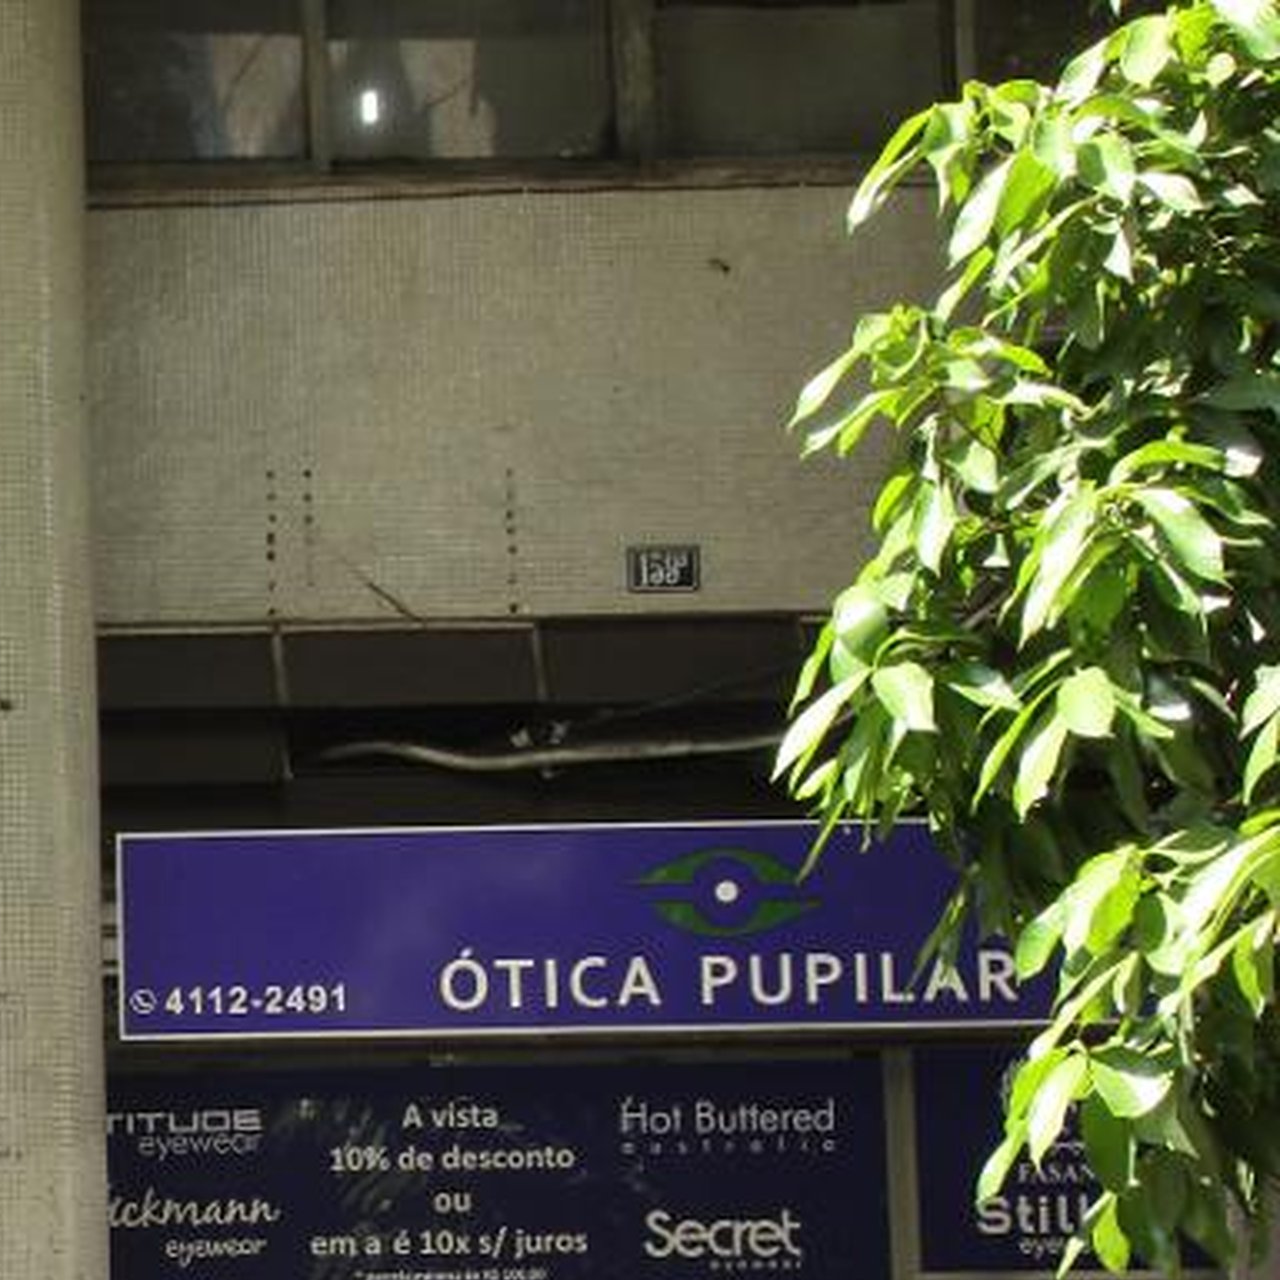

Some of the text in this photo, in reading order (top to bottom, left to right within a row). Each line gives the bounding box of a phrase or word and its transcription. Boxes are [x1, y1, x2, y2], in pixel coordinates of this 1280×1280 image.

[440, 947, 1018, 1010] ÓTICA PUPILAR
[165, 984, 347, 1014] 4112-2491
[431, 1101, 500, 1129] vista
[696, 1098, 835, 1134] Buttered
[330, 1143, 576, 1172] 10% de desconto
[433, 1192, 472, 1213] ou
[310, 1235, 357, 1257] em
[420, 1231, 471, 1255] 10x
[514, 1229, 589, 1260] juros
[644, 1209, 802, 1258] Secret
